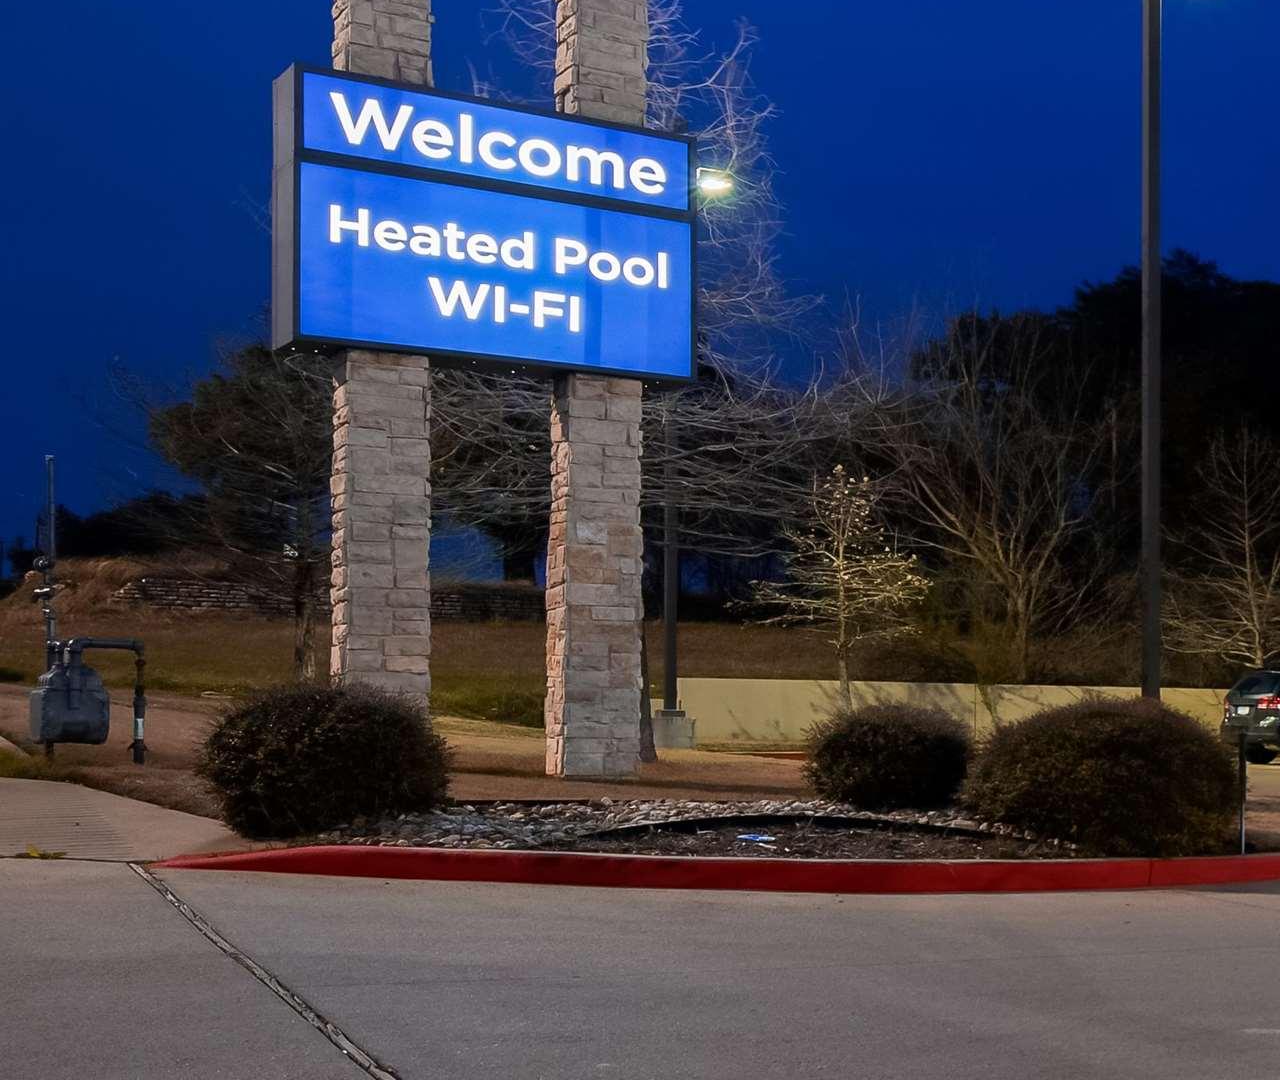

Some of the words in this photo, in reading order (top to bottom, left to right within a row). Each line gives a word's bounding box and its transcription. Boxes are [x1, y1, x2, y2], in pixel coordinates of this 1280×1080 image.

[329, 91, 667, 195] Welcome
[328, 204, 535, 270] Heated
[554, 237, 669, 289] Pool
[427, 276, 581, 333] WI-FI
